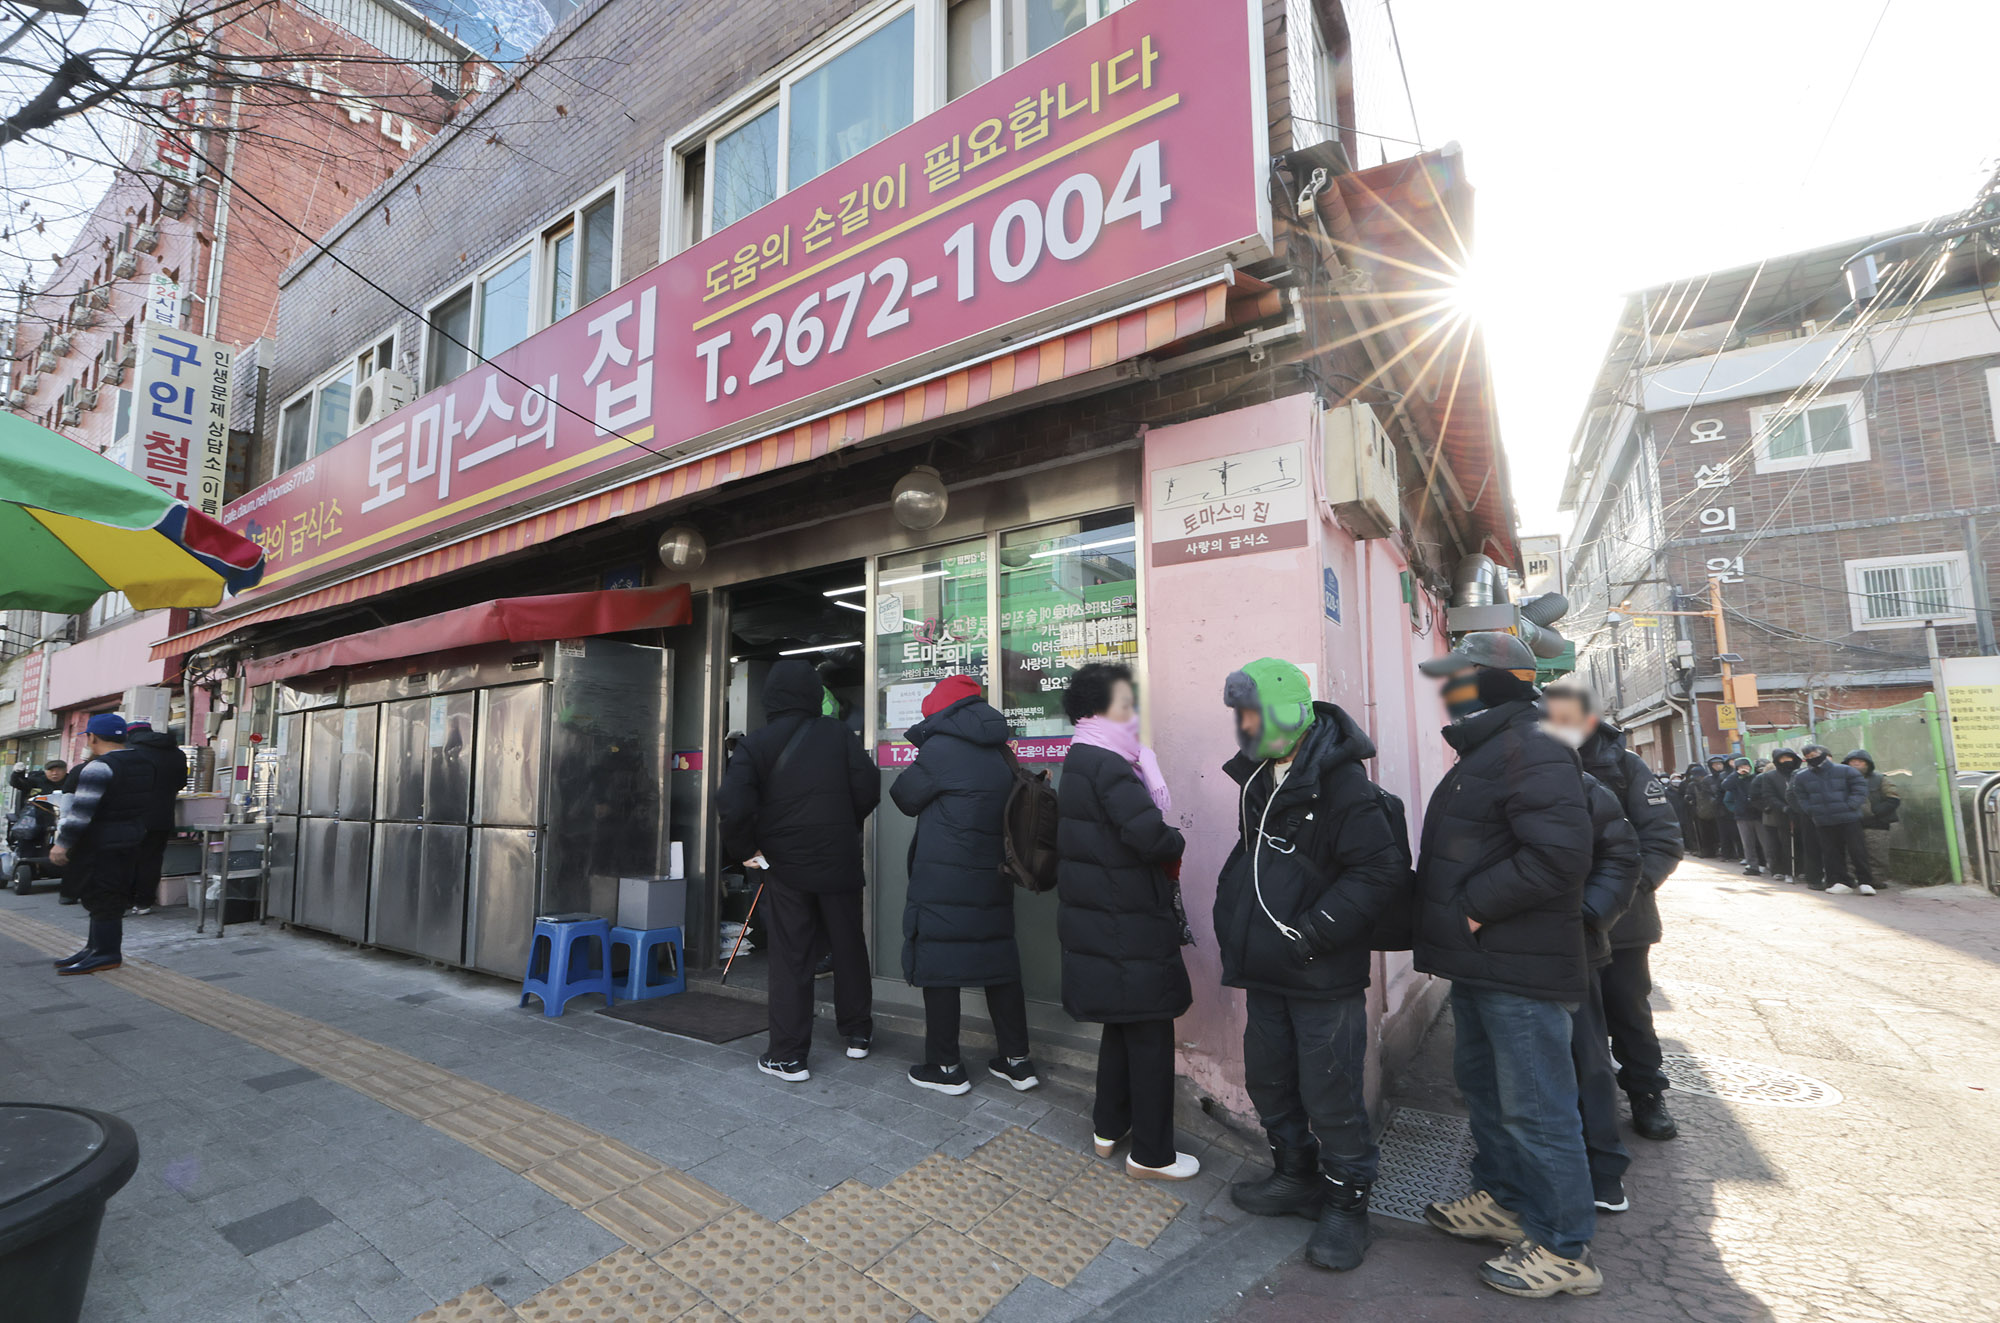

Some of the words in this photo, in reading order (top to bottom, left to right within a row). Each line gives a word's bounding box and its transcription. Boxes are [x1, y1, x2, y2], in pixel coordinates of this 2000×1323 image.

[702, 224, 790, 303] 도움의
[801, 163, 906, 254] 손길이
[923, 34, 1159, 193] 필요합니다
[209, 351, 229, 419] 인생문제
[361, 373, 558, 514] 토마스의
[582, 287, 658, 437] 집
[204, 421, 225, 472] 상담소
[290, 498, 343, 556] 급식소
[1183, 502, 1246, 535] 토마스의
[1252, 501, 1270, 524] 집
[1185, 539, 1222, 555] 사랑의
[1228, 533, 1269, 549] 급식소
[1019, 656, 1052, 672] 사랑의
[1017, 745, 1045, 757] 도움의
